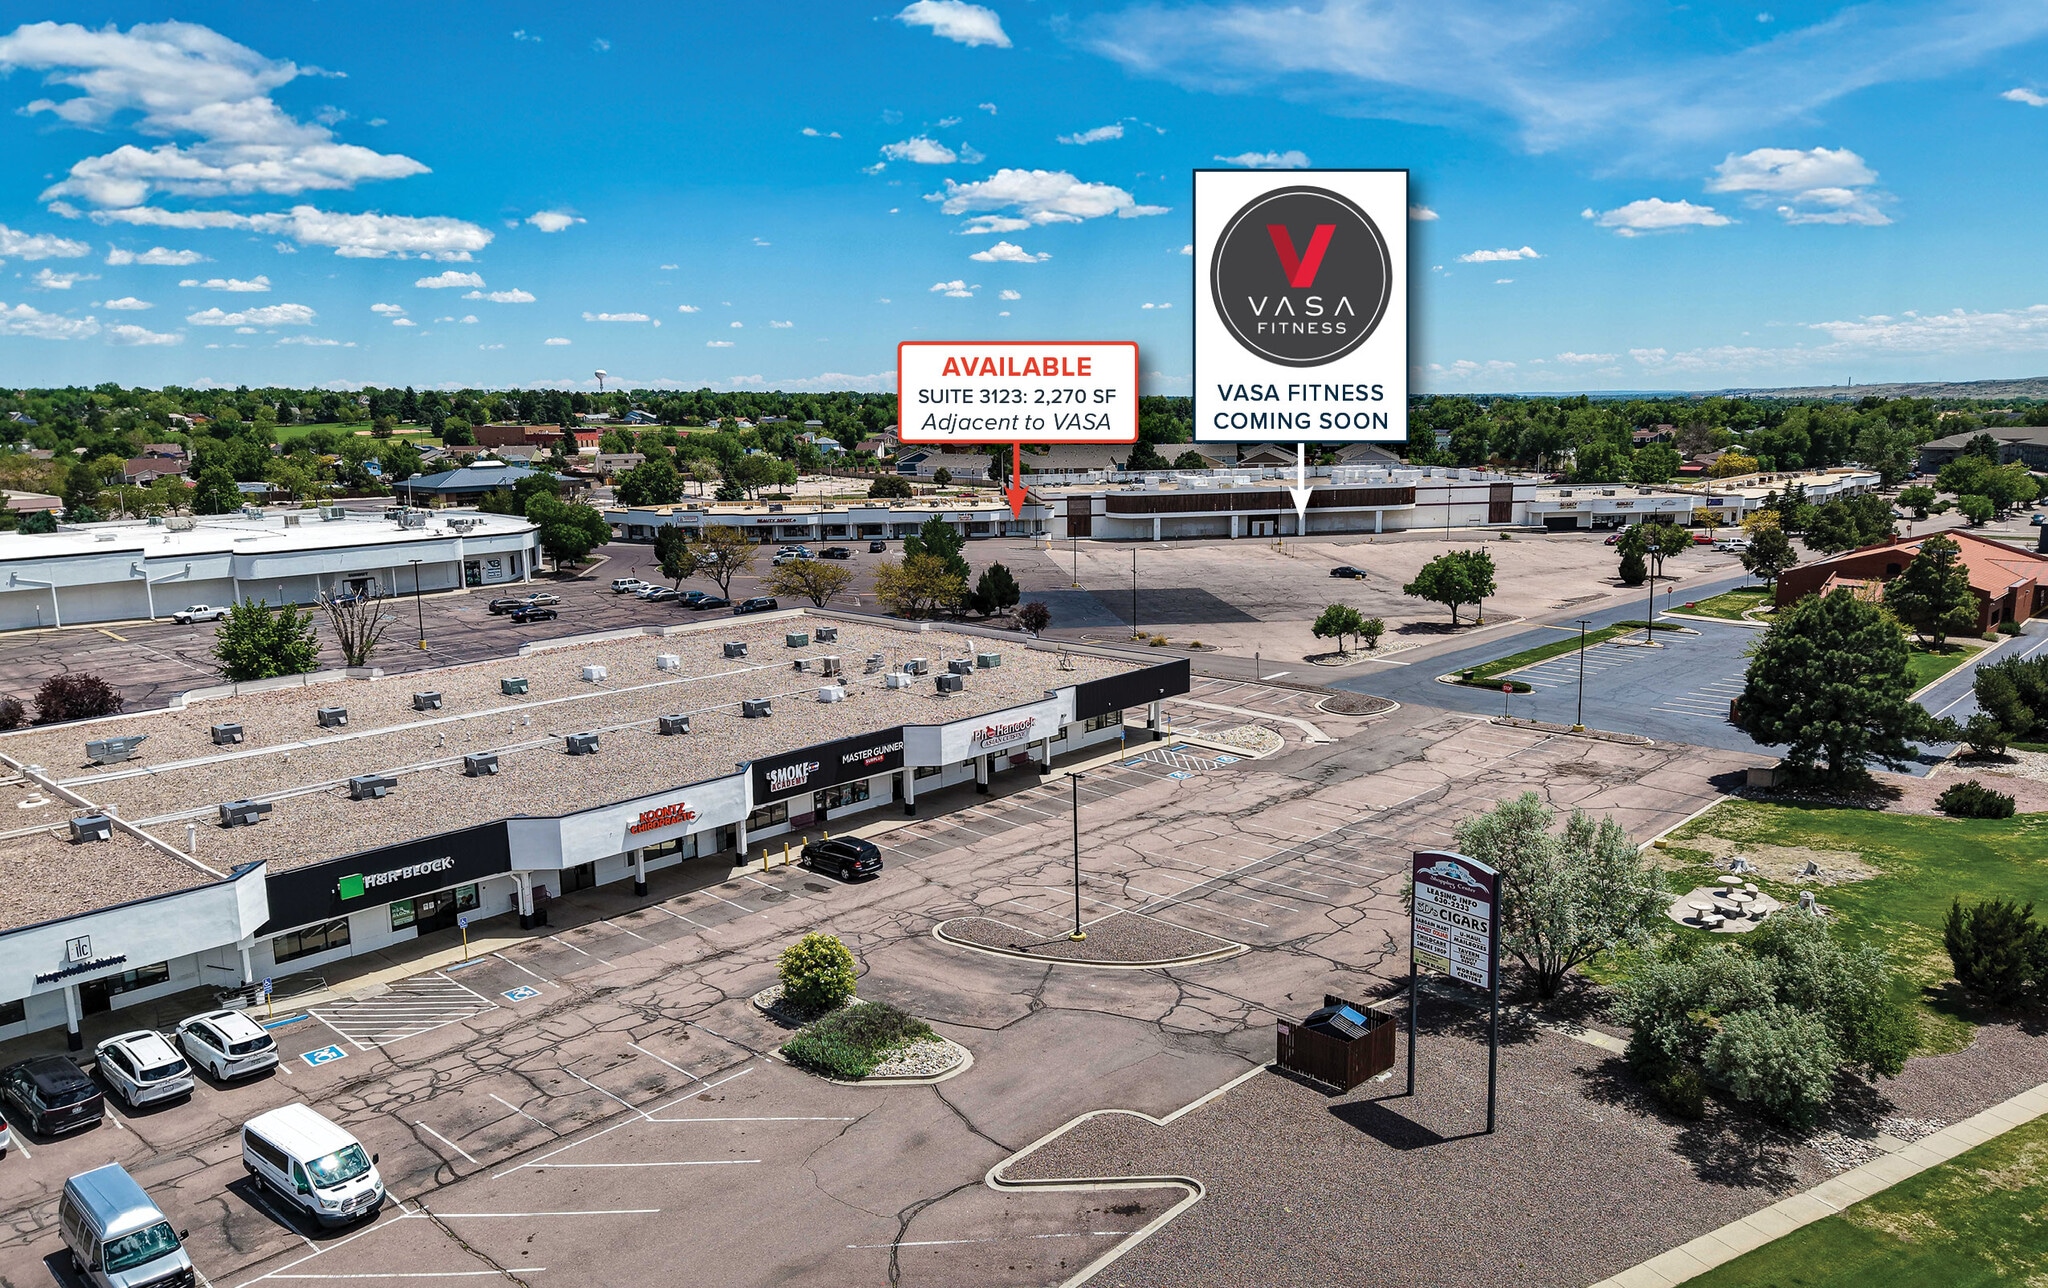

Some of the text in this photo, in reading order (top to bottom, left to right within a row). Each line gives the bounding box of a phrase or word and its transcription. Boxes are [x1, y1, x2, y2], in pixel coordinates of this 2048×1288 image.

[842, 741, 904, 764] MASTER GUNNER
[770, 762, 809, 784] SMOKE
[772, 776, 806, 791] ACADEMY
[630, 810, 696, 834] CHIROPRACTIC
[639, 802, 685, 823] KOONTZ
[364, 856, 454, 889] H&R BLOCK
[1430, 875, 1456, 889] Shopping
[1426, 887, 1478, 908] LEASING INFO
[1439, 909, 1488, 933] CIGARS
[1454, 937, 1487, 952] MAILBOXES
[1460, 932, 1482, 942] U-HAUL
[75, 939, 88, 958] ilc
[1458, 947, 1480, 958] TAVERN
[1456, 966, 1483, 979] WORSHIP
[1457, 972, 1482, 984] CENTERS
